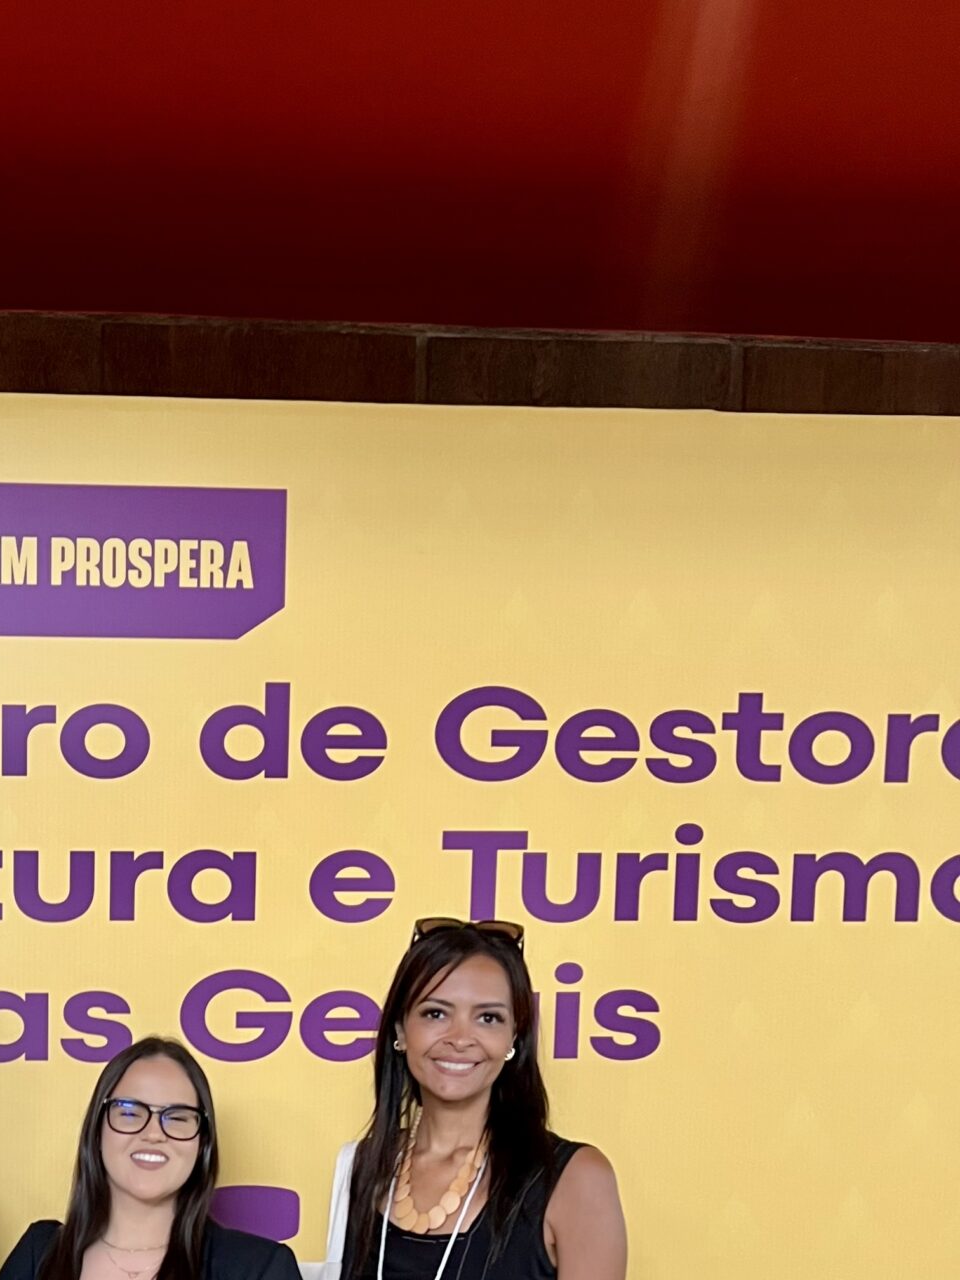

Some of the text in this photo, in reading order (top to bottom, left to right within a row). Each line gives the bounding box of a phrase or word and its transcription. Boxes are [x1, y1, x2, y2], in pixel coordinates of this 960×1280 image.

[51, 537, 254, 589] PROSPERA
[199, 681, 388, 781] de
[434, 685, 960, 784] Gestor
[309, 848, 396, 923] e
[180, 962, 662, 1063] Geis
